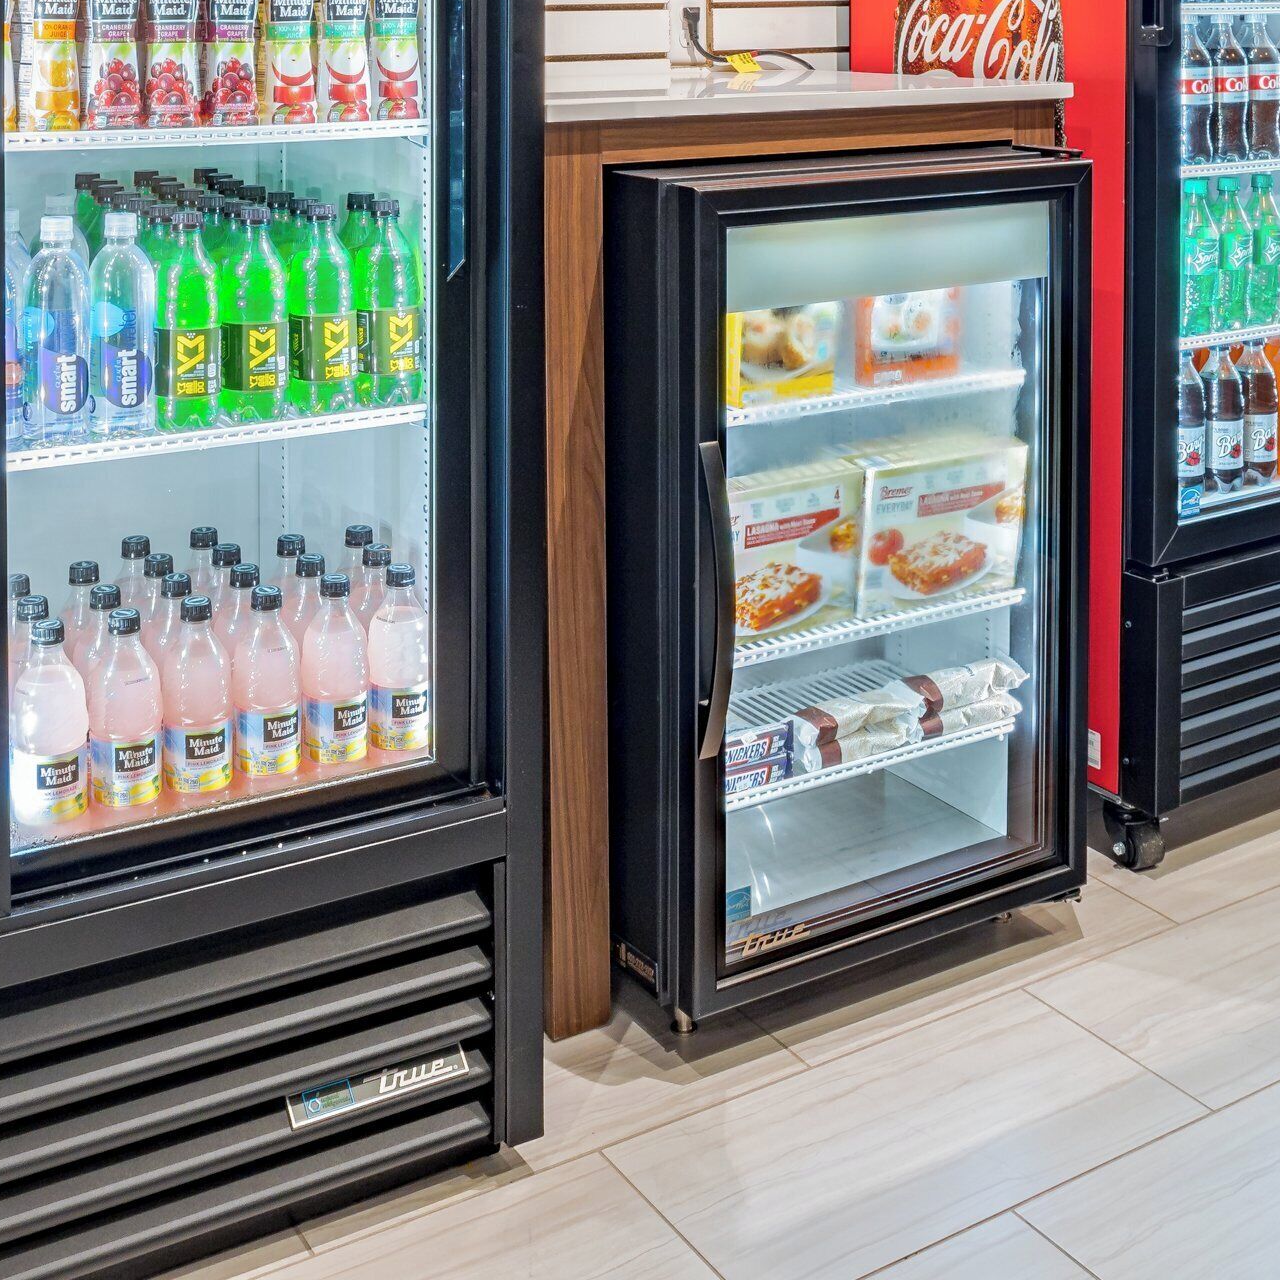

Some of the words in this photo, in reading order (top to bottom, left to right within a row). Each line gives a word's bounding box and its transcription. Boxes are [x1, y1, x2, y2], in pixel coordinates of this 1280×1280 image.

[45, 3, 74, 15] Maid
[102, 4, 134, 16] Maid
[154, 5, 186, 16] Maid
[221, 4, 249, 16] Maid
[280, 5, 308, 17] Maid
[336, 5, 363, 16] Maid
[385, 3, 415, 14] Maid
[57, 354, 77, 412] smart
[118, 349, 137, 405] smart
[834, 489, 840, 500] 4
[880, 486, 912, 499] Bremer
[876, 500, 913, 514] EVERYDAY
[396, 695, 426, 708] Minute
[337, 706, 365, 720] Minute
[400, 704, 423, 716] Maid
[267, 716, 297, 731] Minute
[342, 715, 365, 727] Maid
[272, 727, 294, 739] Maid
[189, 735, 223, 748] Minute
[119, 746, 153, 761] Minute
[194, 745, 220, 756] Maid
[726, 741, 766, 764] NICKERS
[124, 757, 150, 769] Maid
[40, 764, 76, 778] Minute
[45, 774, 72, 786] Maid
[730, 923, 811, 956] true
[363, 1058, 453, 1093] true
